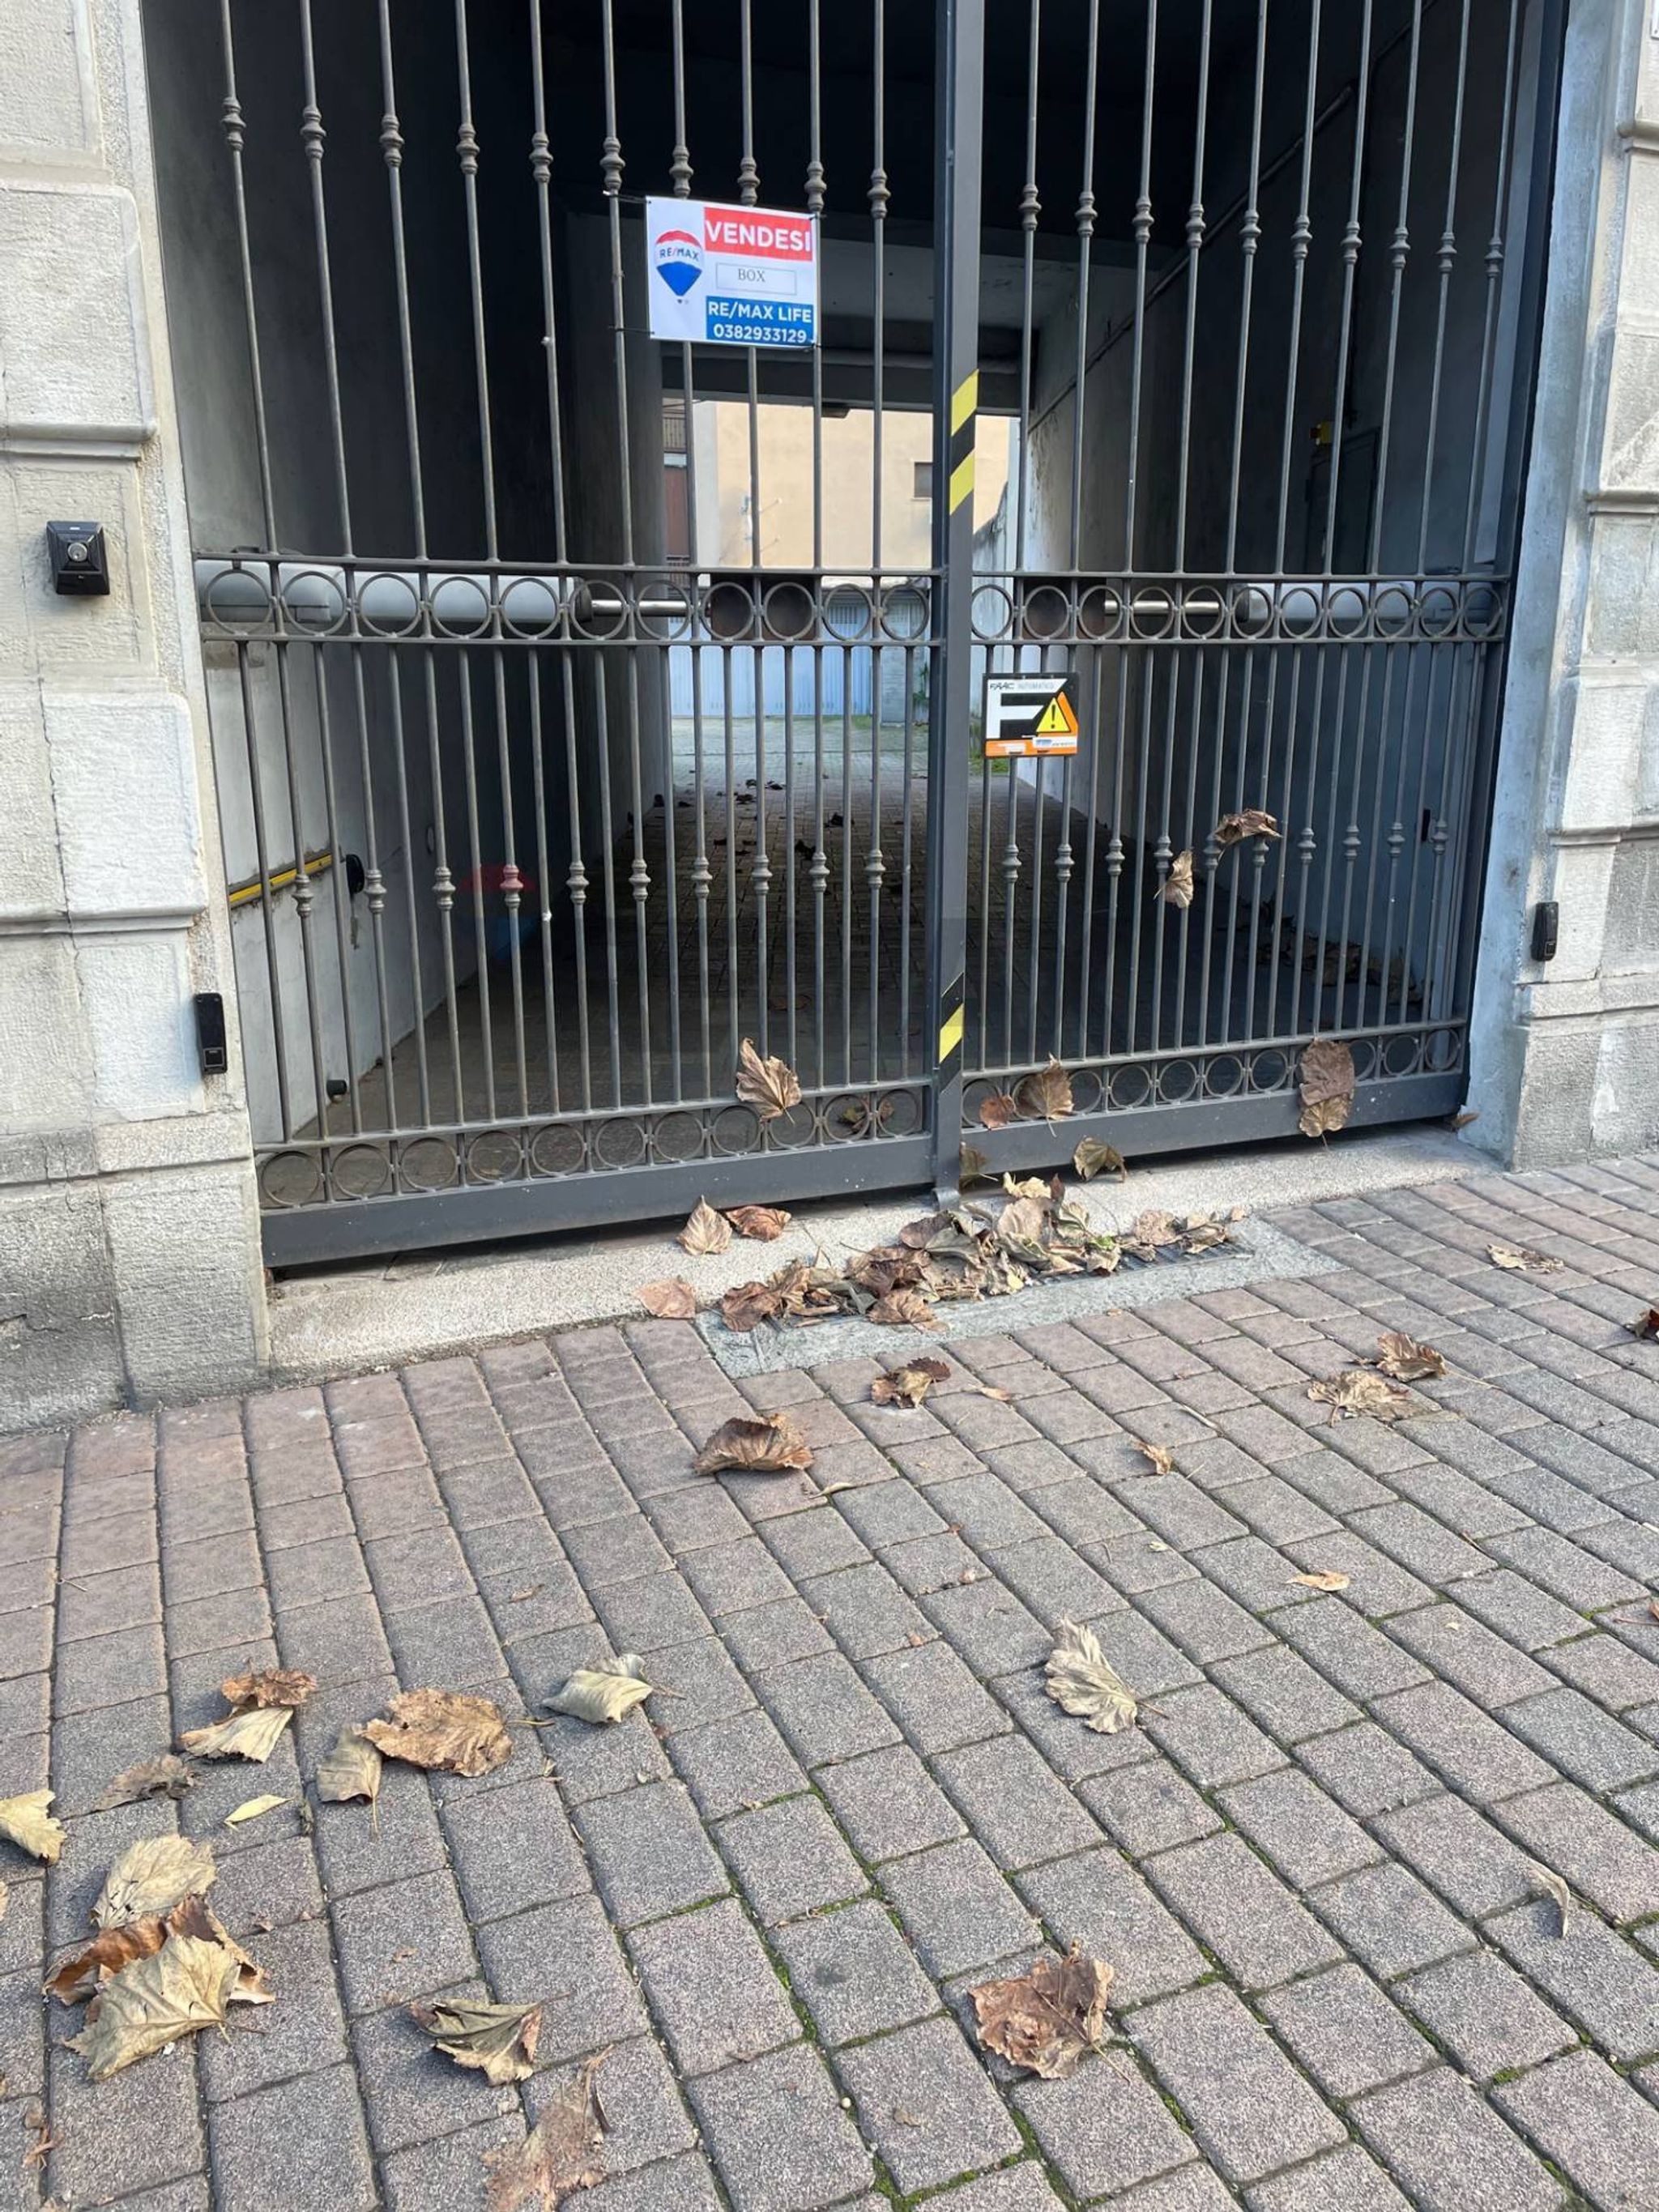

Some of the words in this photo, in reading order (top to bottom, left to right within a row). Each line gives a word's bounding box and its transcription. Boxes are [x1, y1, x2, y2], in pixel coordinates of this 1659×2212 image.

[706, 220, 811, 252] VENDESI
[659, 247, 700, 262] RE/MAX
[738, 268, 766, 283] BOX
[709, 301, 774, 320] RE/MAX
[778, 307, 812, 322] LIFE
[713, 323, 807, 343] 0382933129
